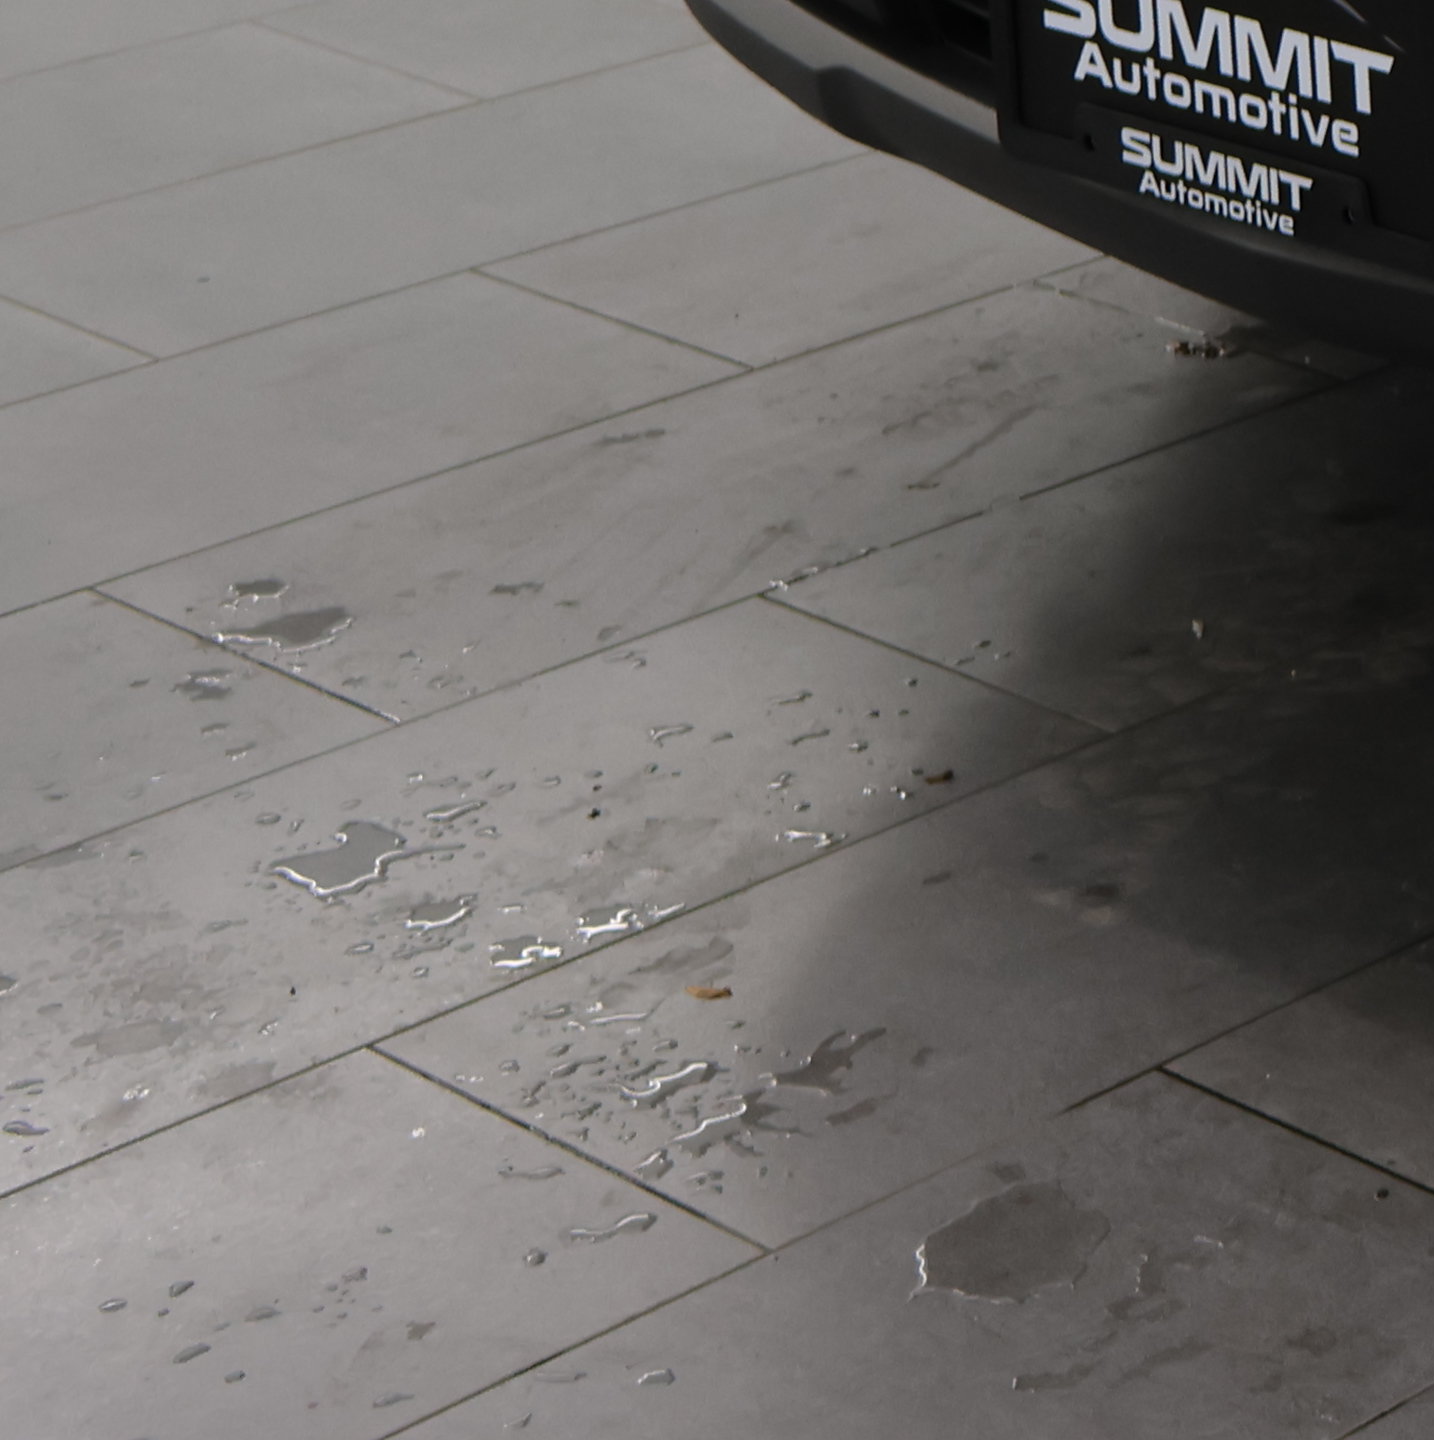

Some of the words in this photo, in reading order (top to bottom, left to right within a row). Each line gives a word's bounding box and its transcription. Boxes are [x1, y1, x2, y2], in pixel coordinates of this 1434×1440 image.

[1073, 41, 1360, 157] Automotive
[1120, 126, 1313, 211] SUMMIT
[1139, 170, 1295, 236] Automotive
